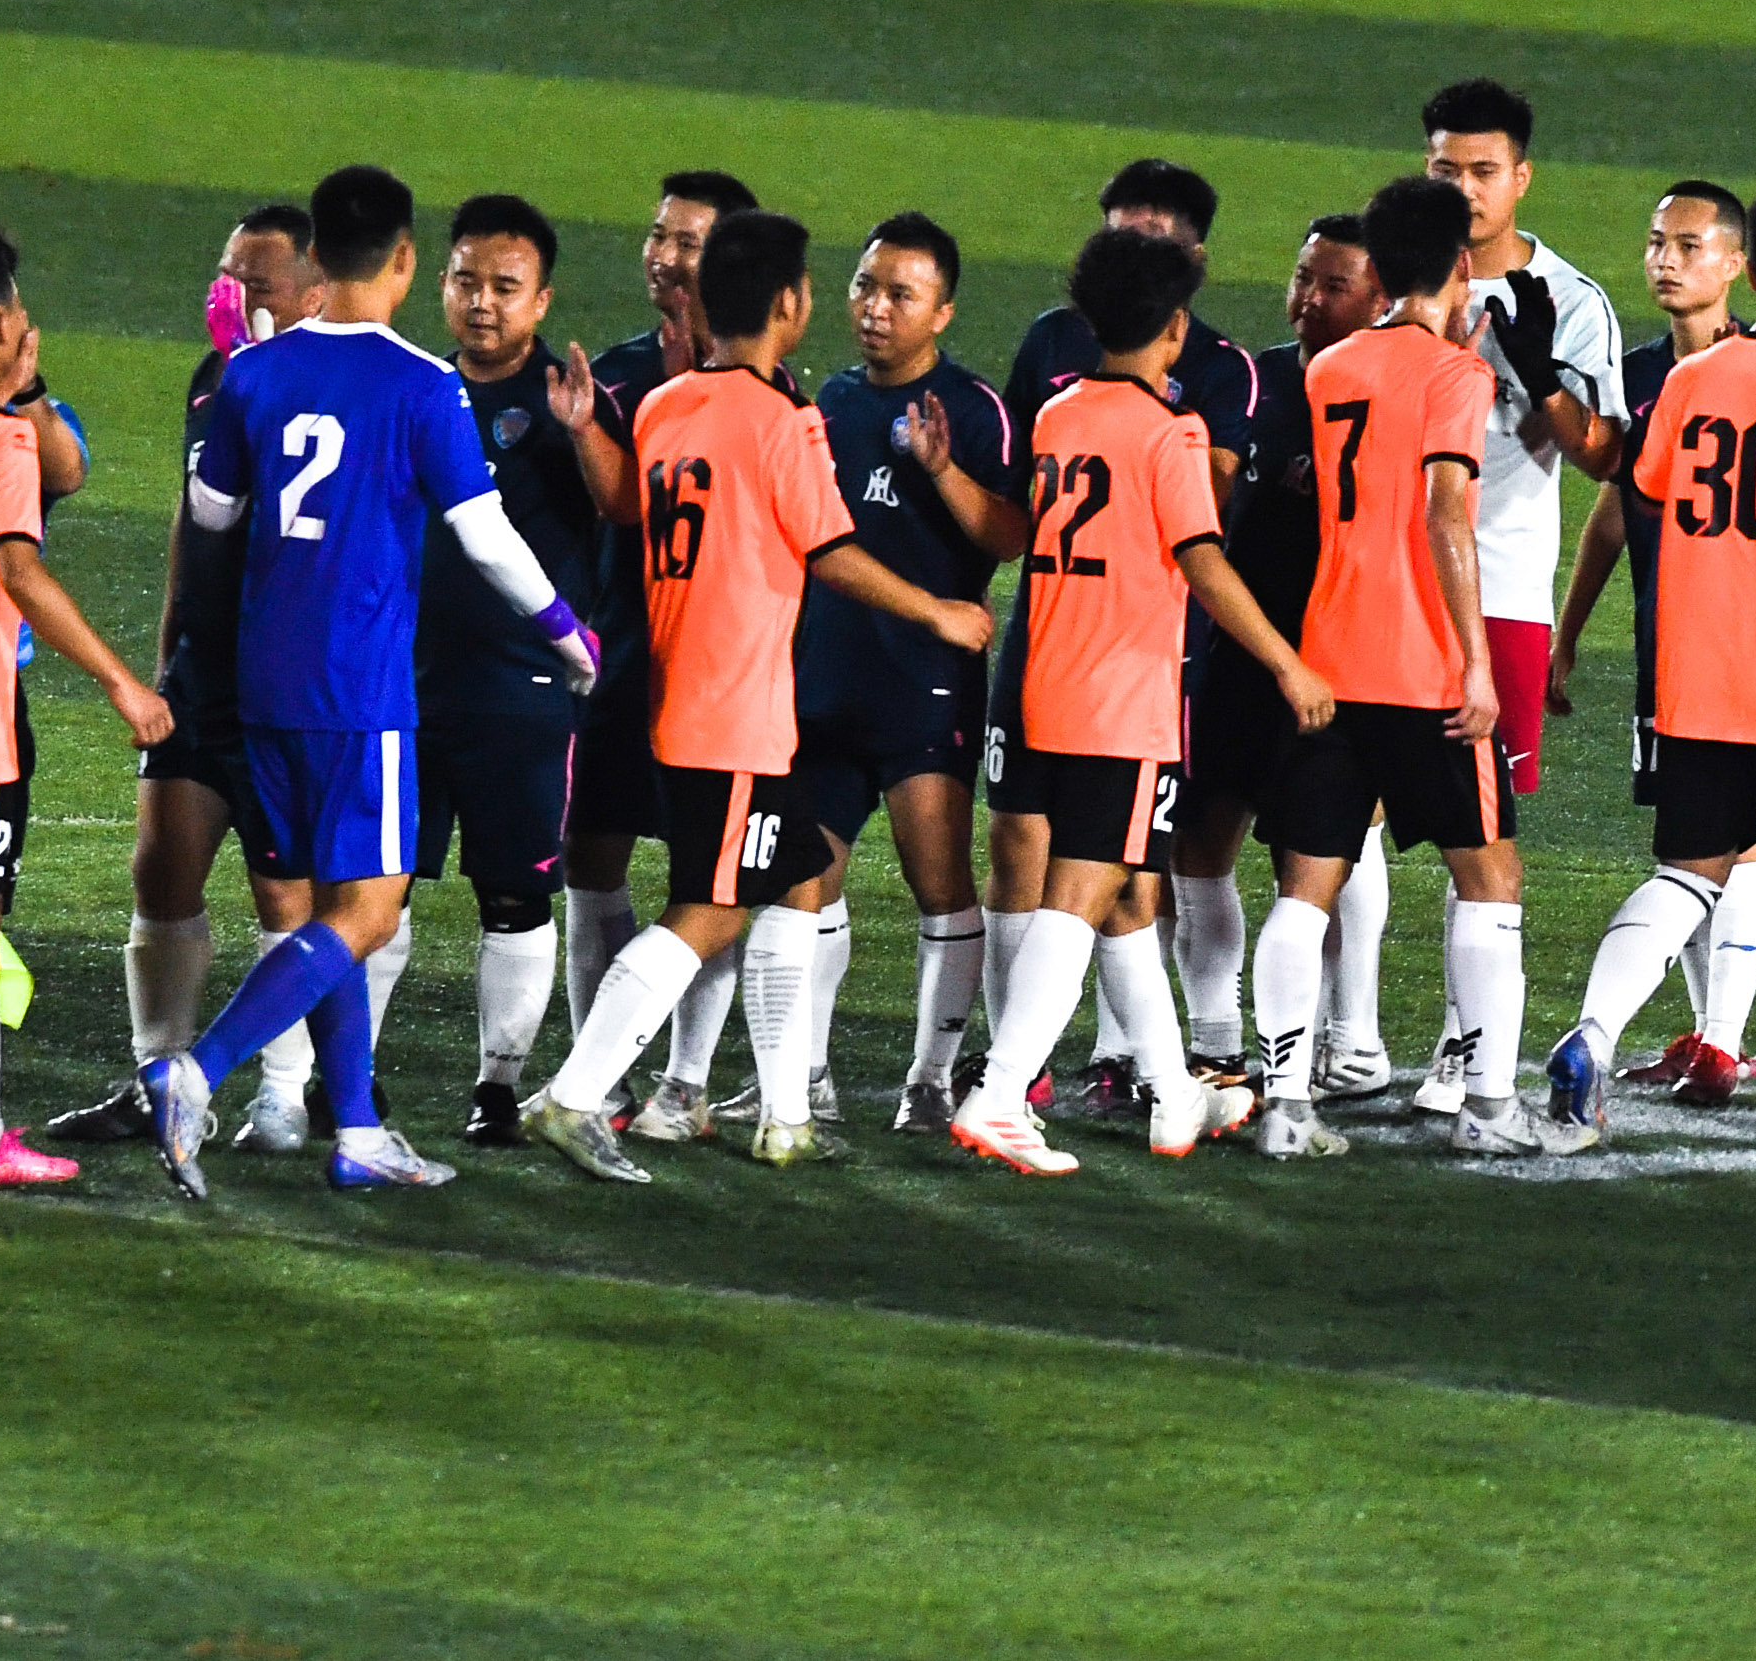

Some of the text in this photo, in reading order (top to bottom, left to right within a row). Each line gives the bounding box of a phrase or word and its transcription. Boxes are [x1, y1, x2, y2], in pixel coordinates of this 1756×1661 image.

[279, 412, 346, 541] 2
[648, 456, 711, 581] 16
[1031, 453, 1111, 577] 22
[1324, 398, 1371, 523] 7
[741, 810, 782, 871] 16
